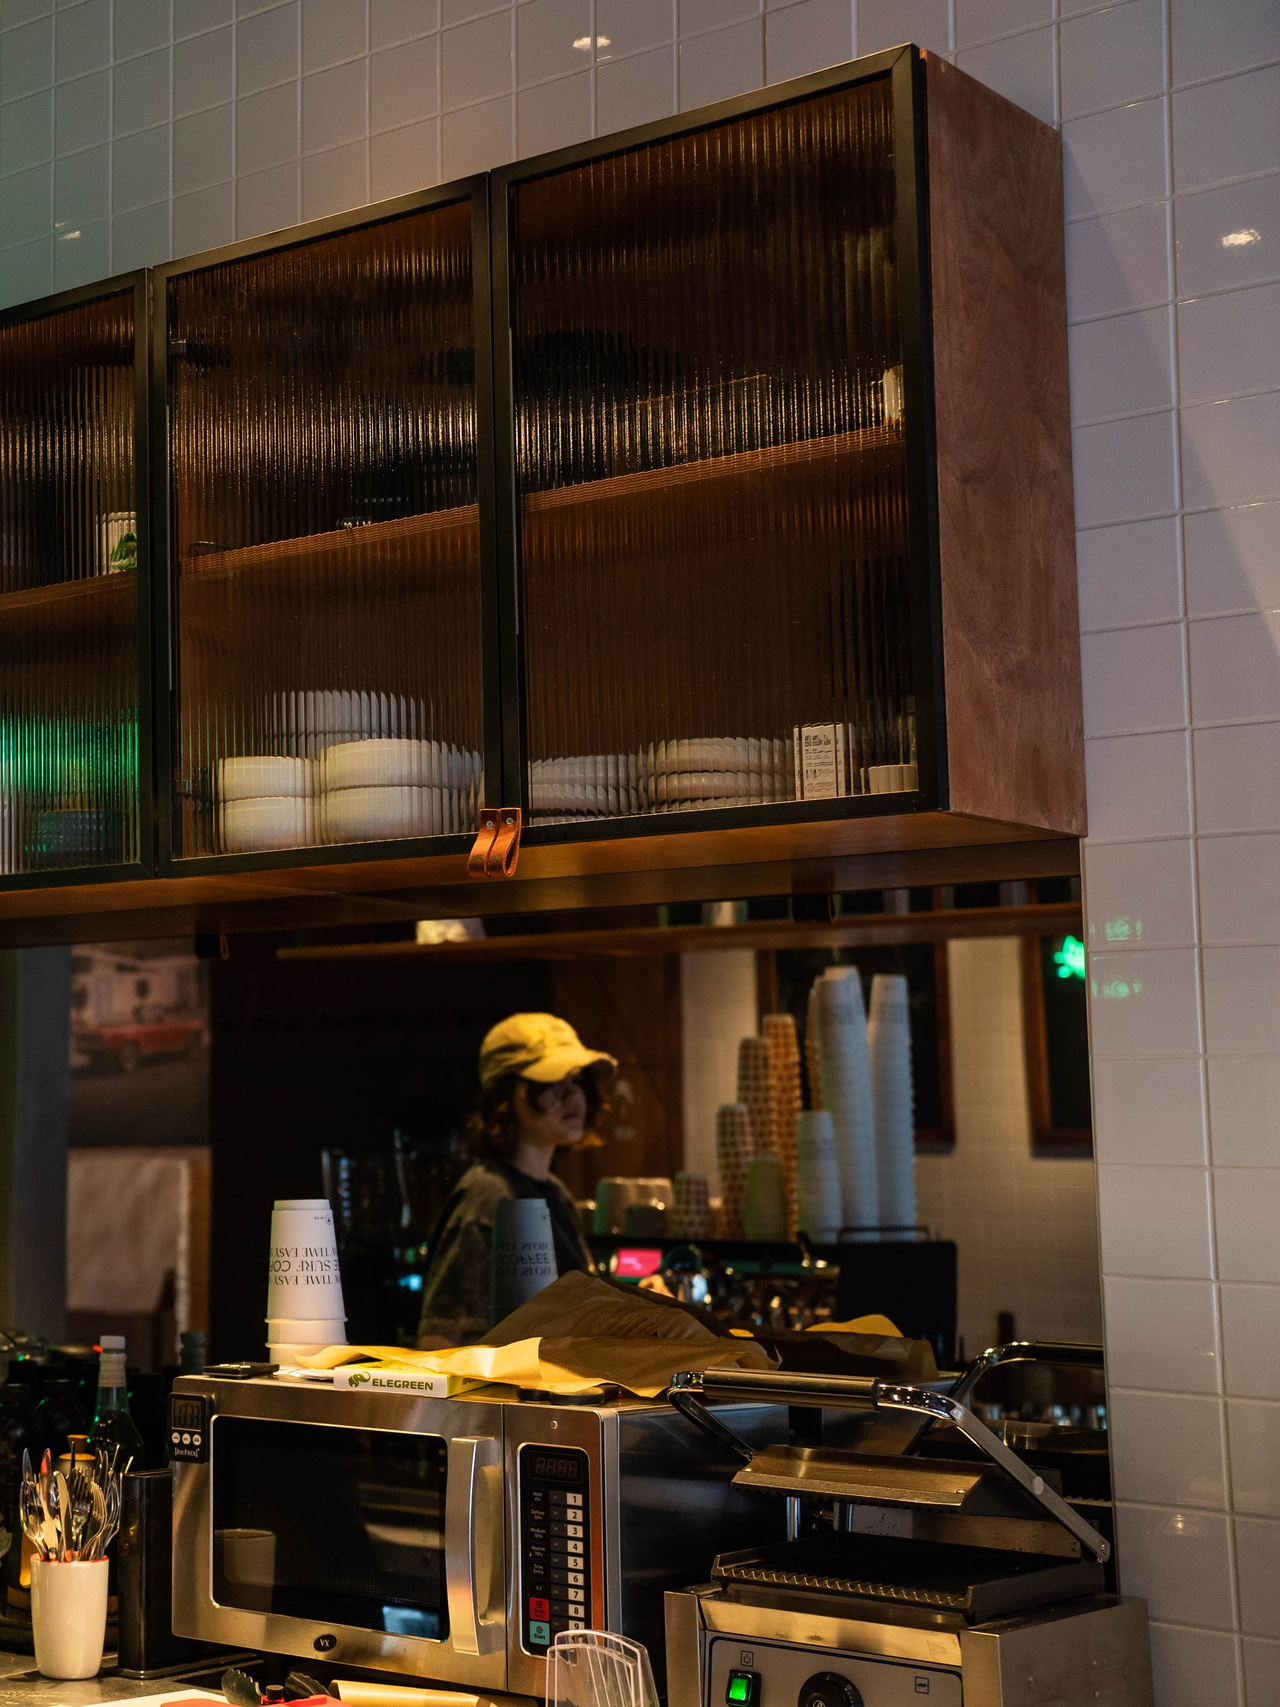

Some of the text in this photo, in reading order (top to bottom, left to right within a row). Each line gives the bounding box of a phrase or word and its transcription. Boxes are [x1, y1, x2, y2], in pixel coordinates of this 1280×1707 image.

[274, 1247, 298, 1257] EASY
[302, 1247, 330, 1257] TIME
[296, 1260, 331, 1272] SURF
[274, 1275, 298, 1285] EASY
[303, 1275, 333, 1285] TIME
[372, 1378, 434, 1391] ELEGREEN
[573, 1527, 577, 1535] 3
[573, 1543, 578, 1551] 4
[574, 1607, 578, 1615] 8
[320, 1638, 330, 1648] VX
